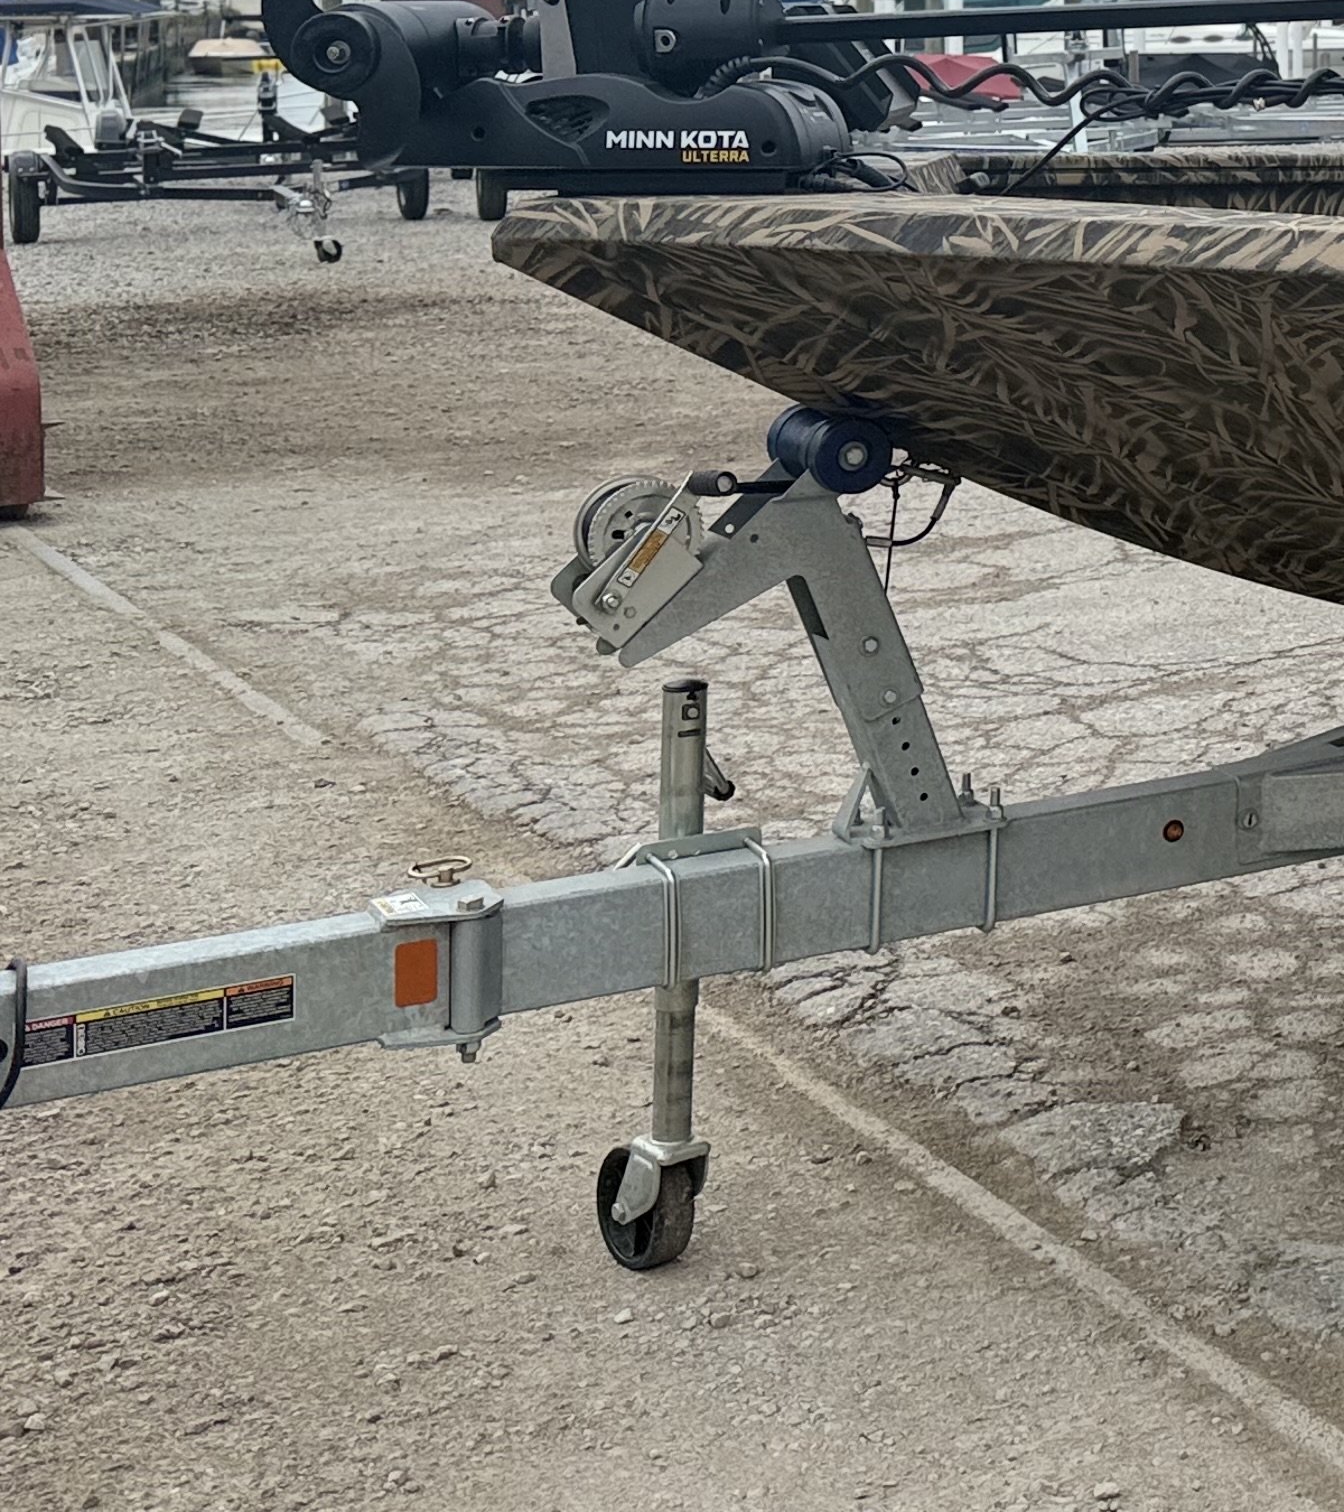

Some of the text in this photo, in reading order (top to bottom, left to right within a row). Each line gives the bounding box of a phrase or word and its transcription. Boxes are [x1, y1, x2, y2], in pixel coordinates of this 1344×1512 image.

[605, 130, 749, 149] MINN KOTA
[682, 150, 749, 163] ULTERRA
[31, 1017, 69, 1032] DANGER
